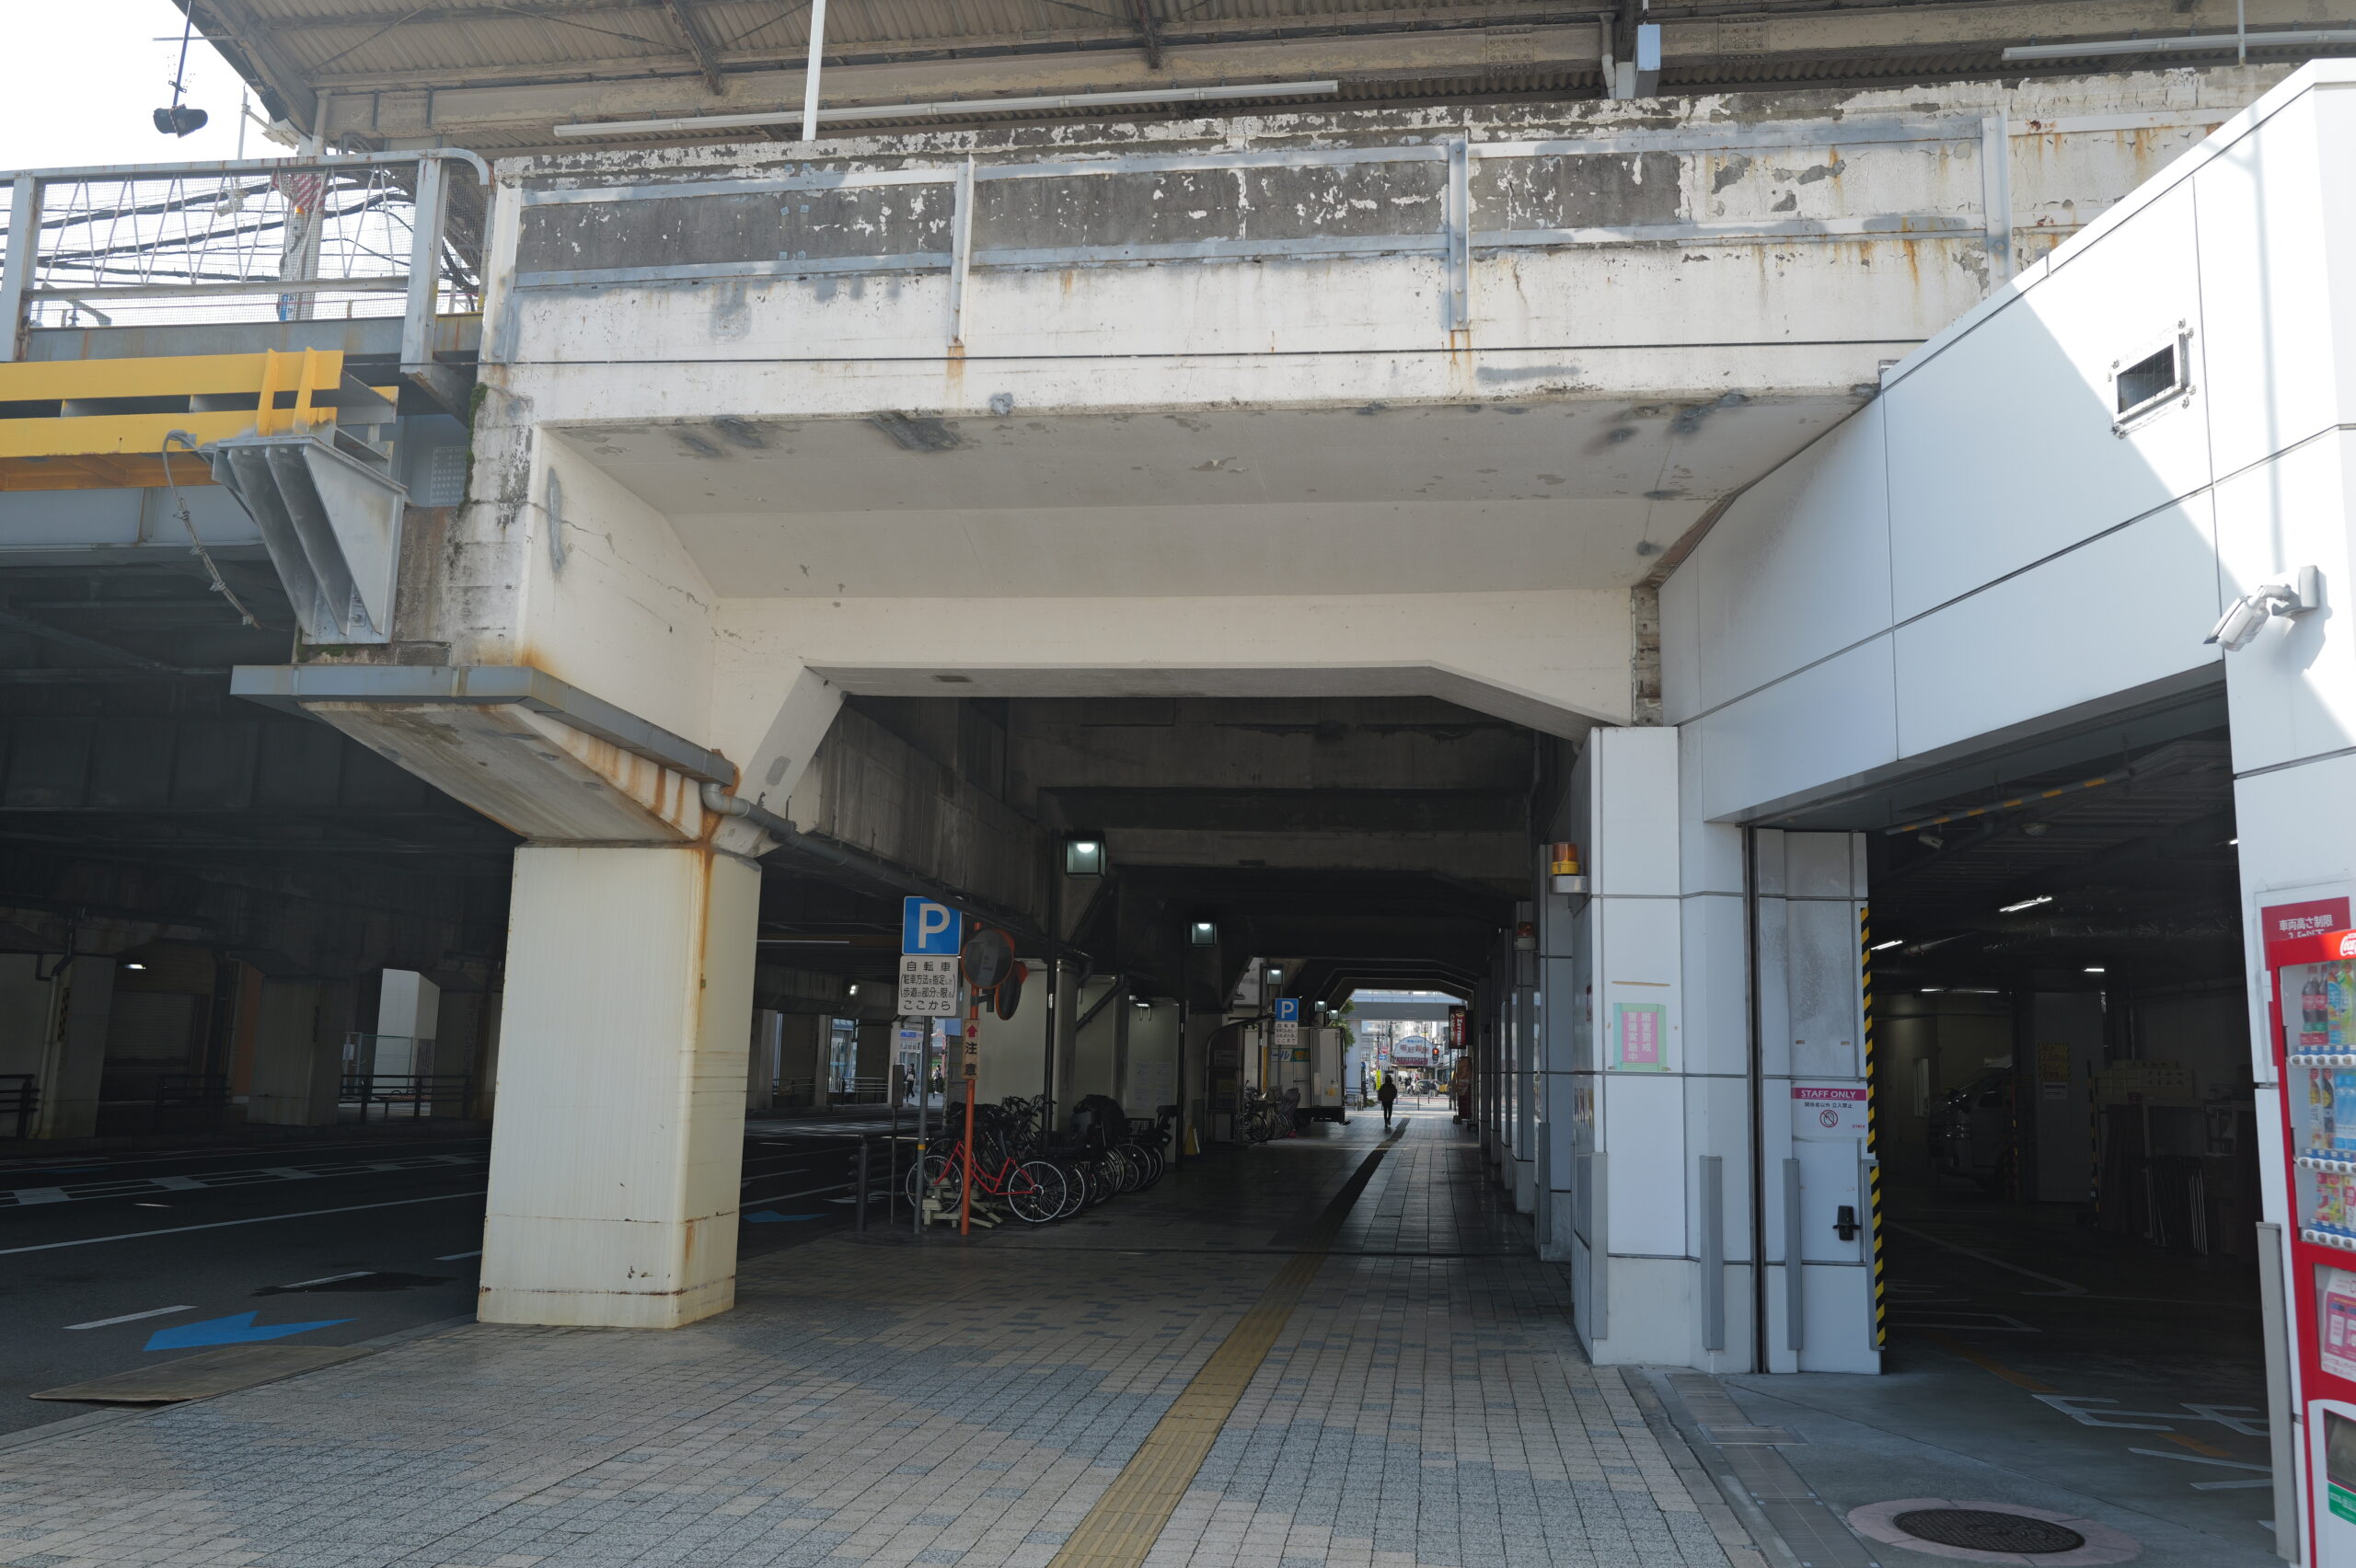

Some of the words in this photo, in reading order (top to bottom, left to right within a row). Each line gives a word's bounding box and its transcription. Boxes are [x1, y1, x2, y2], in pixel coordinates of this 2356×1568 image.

[918, 903, 951, 949] P
[2279, 914, 2334, 931] 車両高さ制限
[907, 962, 951, 973] 自転車
[904, 1000, 951, 1011] ここから
[1280, 1000, 1295, 1019] P
[964, 1042, 977, 1076] 注意
[1801, 1090, 1829, 1098] STAFF
[1831, 1090, 1856, 1099] ONLY
